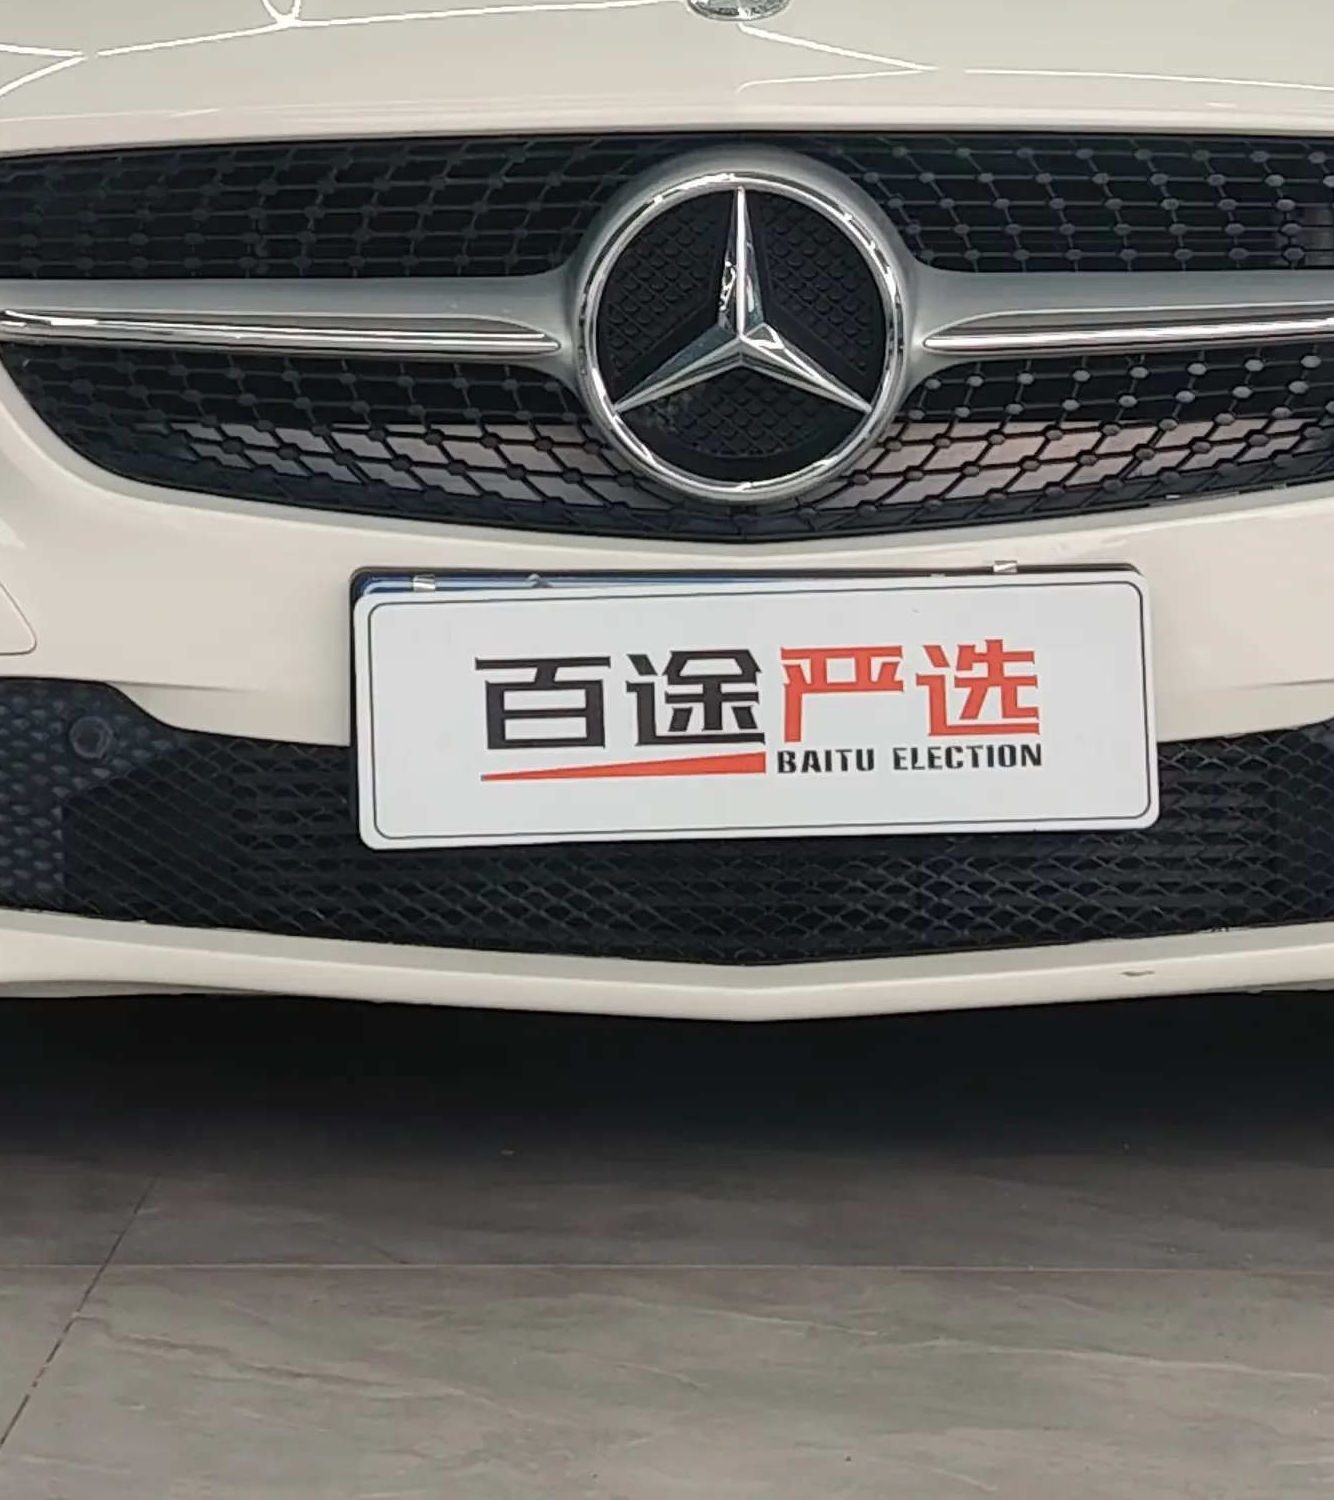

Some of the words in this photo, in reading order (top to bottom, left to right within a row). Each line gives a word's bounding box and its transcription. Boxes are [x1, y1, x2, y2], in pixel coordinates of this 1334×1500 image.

[474, 638, 1041, 750] 百途严选
[777, 748, 876, 775] BAITU
[893, 744, 1043, 772] ELECTION
